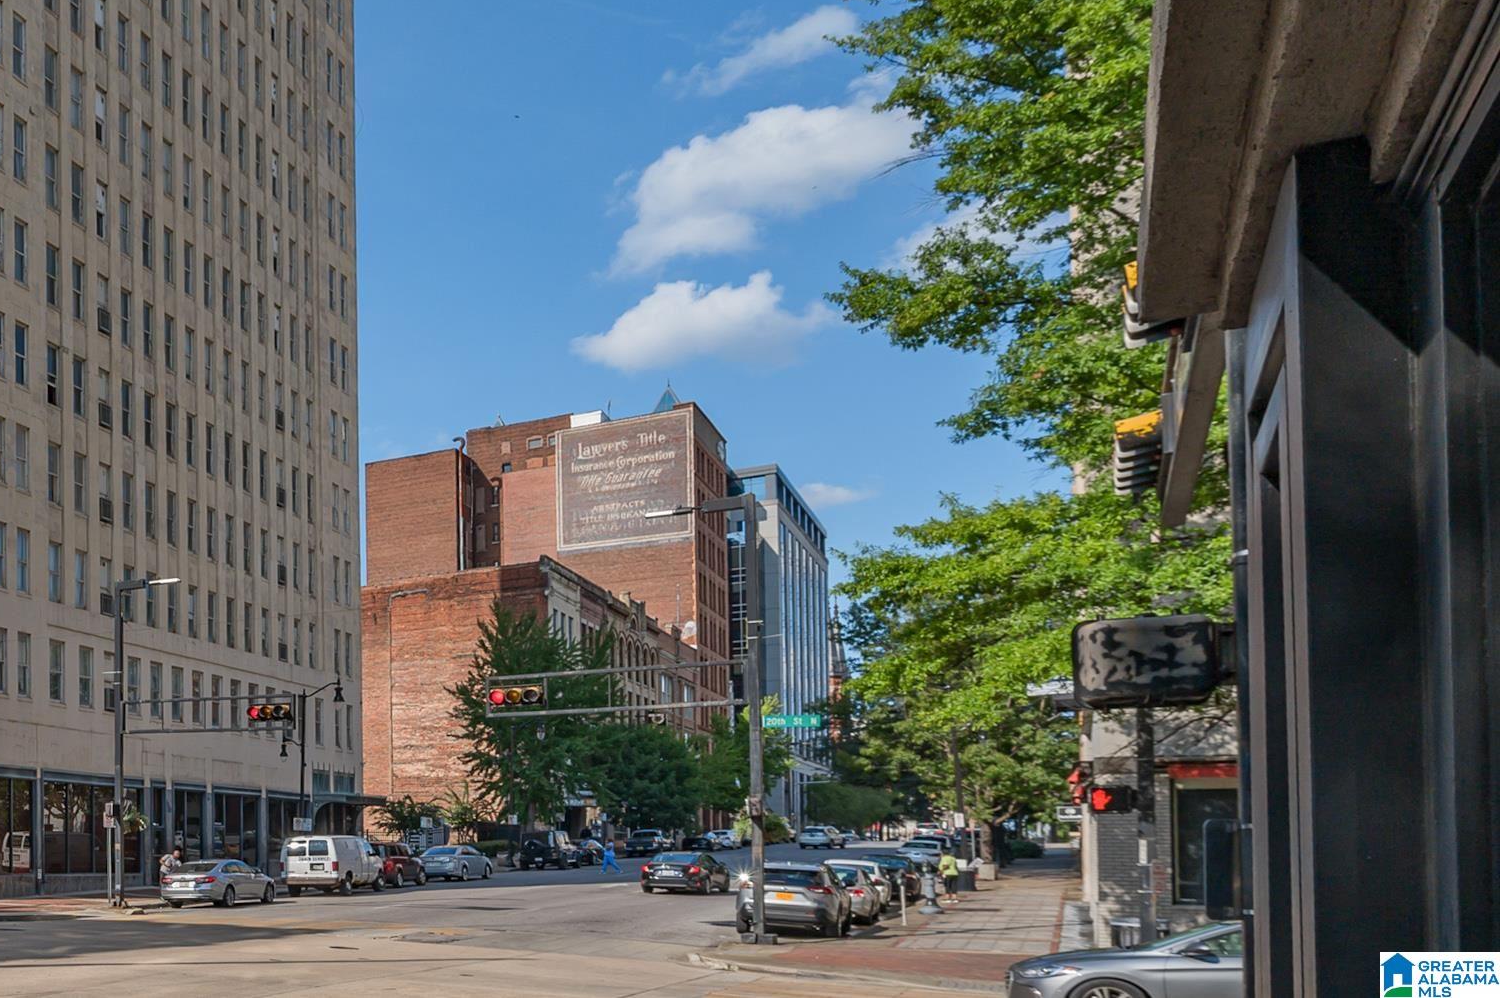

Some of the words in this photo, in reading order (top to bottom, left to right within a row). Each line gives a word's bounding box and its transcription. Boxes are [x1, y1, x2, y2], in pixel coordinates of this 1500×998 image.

[616, 450, 675, 469] Corporation
[766, 717, 786, 726] 20th
[793, 717, 803, 726] St
